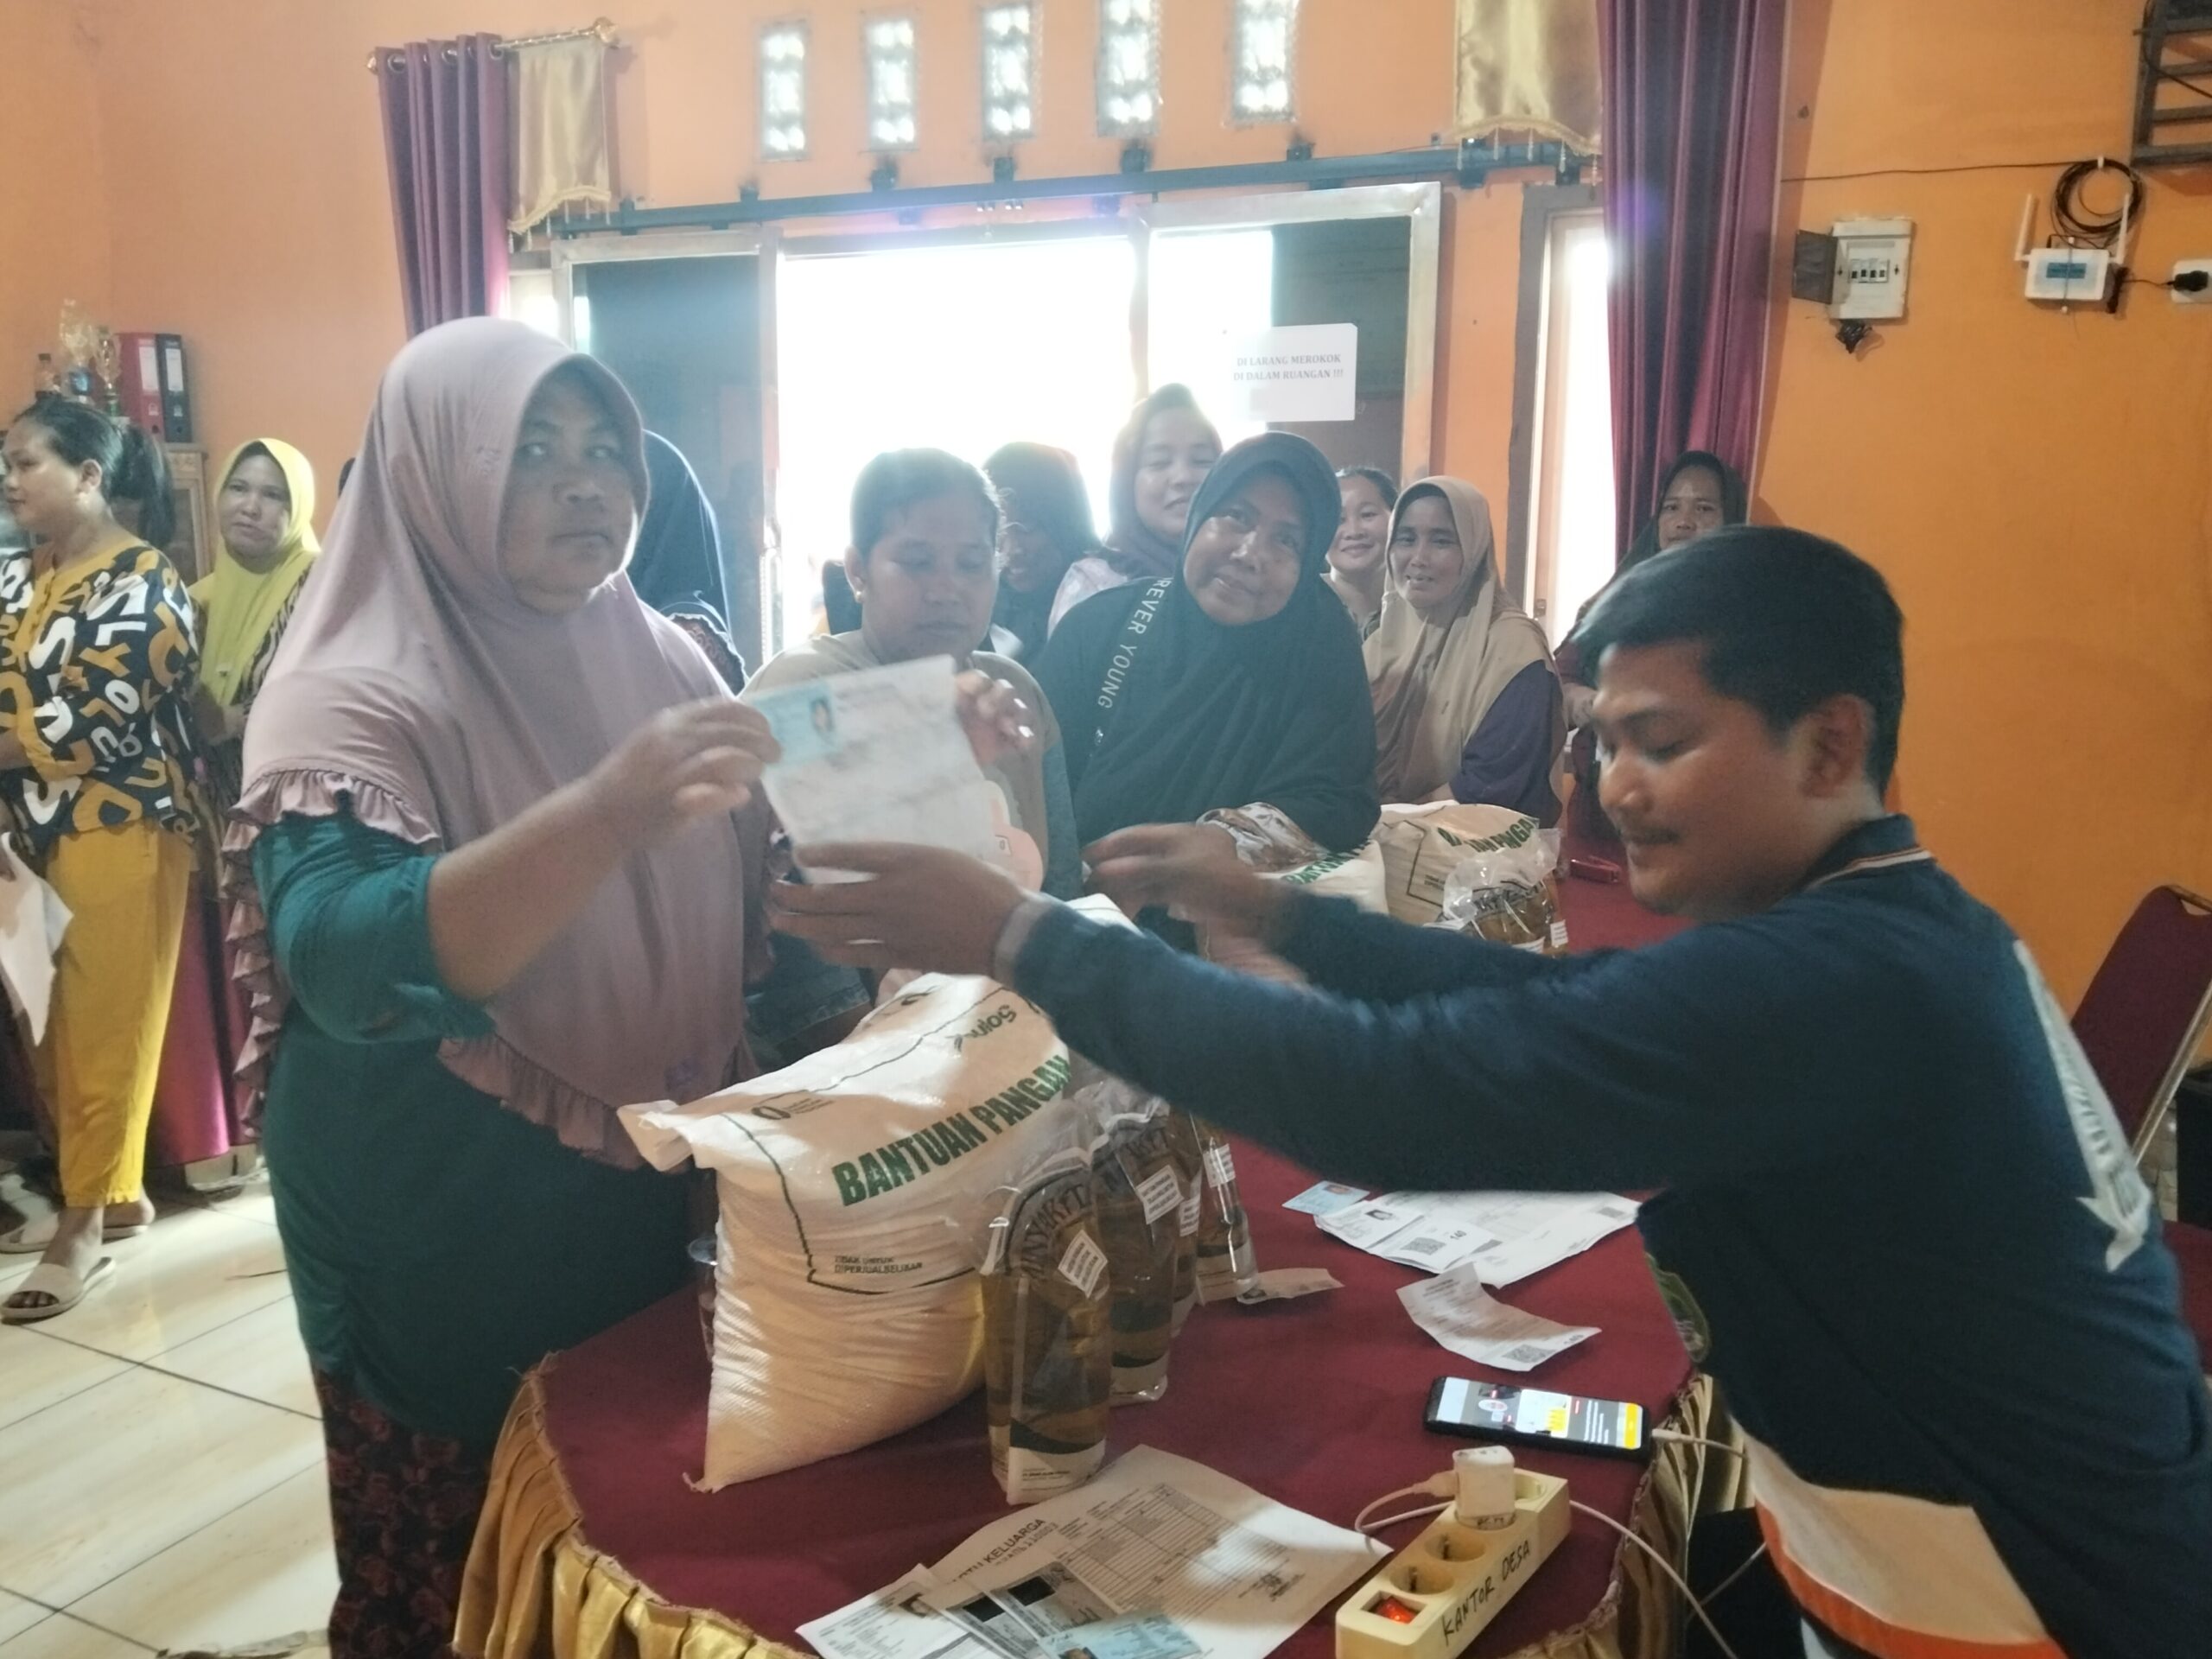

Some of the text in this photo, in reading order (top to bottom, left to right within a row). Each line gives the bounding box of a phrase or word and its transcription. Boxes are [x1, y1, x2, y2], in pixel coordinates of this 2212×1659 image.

[1233, 372, 1244, 381] DI
[1246, 371, 1281, 381] DALAM
[1282, 369, 1331, 380] RUANGAN
[1236, 353, 1341, 366] DI LARANG MEROKOK
[1097, 576, 1174, 709] REVER YOUNG
[831, 1054, 1071, 1206] BANTUAN PANGAN
[983, 1518, 1046, 1563] KELUARGA
[1440, 1576, 1495, 1646] KANTOR
[1502, 1540, 1531, 1582] DESA
